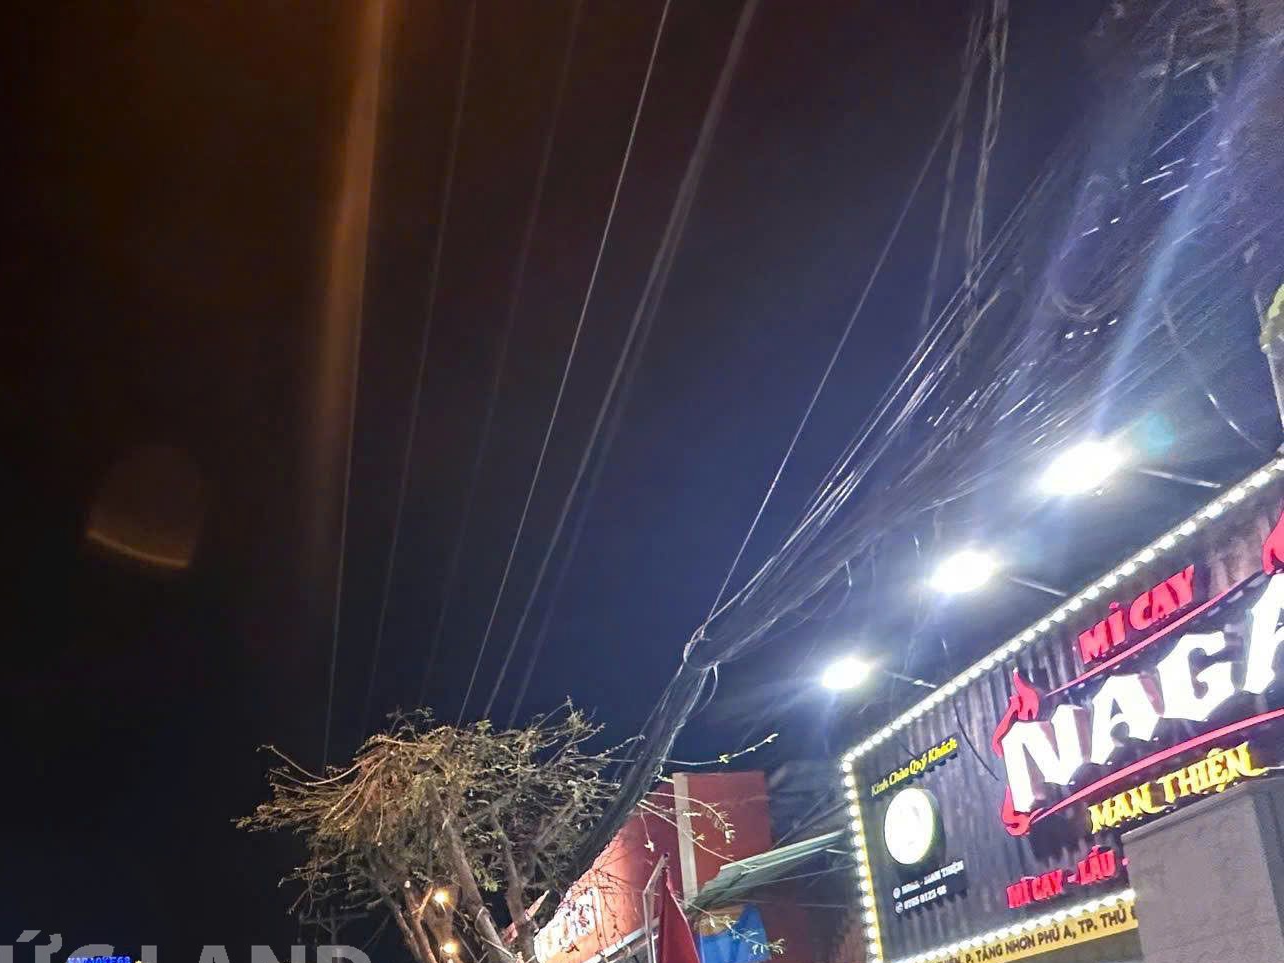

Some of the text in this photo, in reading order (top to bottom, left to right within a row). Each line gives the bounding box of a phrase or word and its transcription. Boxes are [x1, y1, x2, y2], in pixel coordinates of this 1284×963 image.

[1077, 563, 1195, 665] MÌ CAY
[1088, 740, 1269, 834] MAN THIỆN
[1031, 868, 1064, 901] CAY
[1063, 923, 1078, 940] A,
[1077, 917, 1099, 935] TP.
[1099, 902, 1128, 929] THỦ
